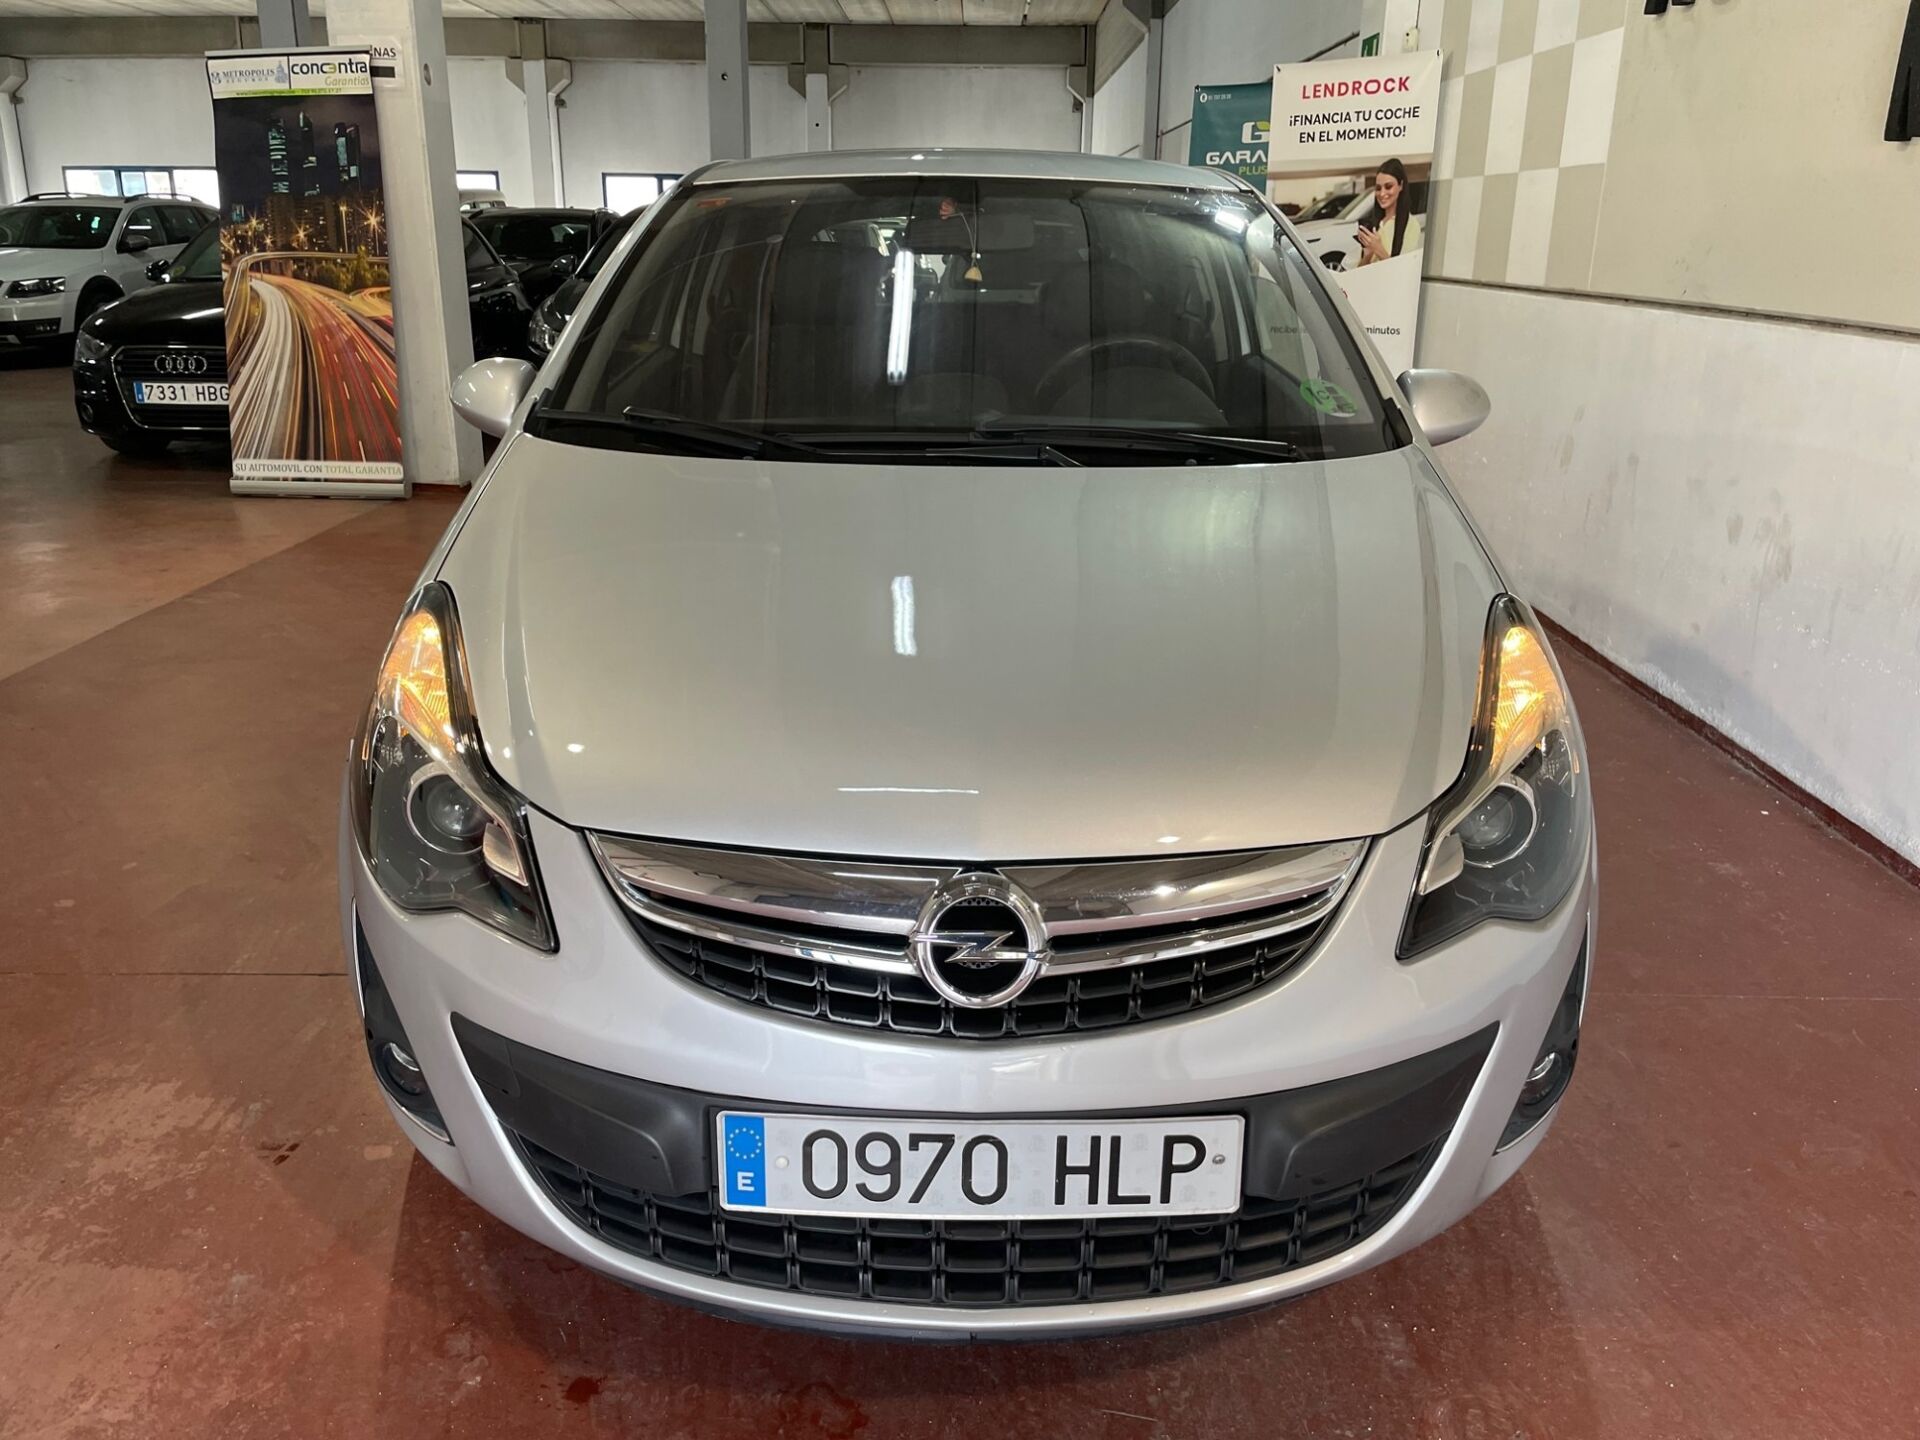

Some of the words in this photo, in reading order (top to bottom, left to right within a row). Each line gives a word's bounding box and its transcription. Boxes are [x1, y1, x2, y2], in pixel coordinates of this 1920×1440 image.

[222, 69, 275, 78] METROPOLIS
[1302, 76, 1410, 100] LENDROCK
[1289, 111, 1352, 127] ¡FINANCIA
[1354, 110, 1372, 122] TU
[1375, 106, 1420, 120] COCHE
[1299, 131, 1316, 143] EN
[1319, 130, 1333, 142] EL
[1336, 125, 1407, 141] MOMENTO!
[145, 385, 187, 401] 7331
[195, 386, 230, 401] HBG
[235, 463, 247, 472] SU
[249, 464, 302, 473] AUTOMOVIL
[304, 465, 323, 473] CON
[324, 465, 353, 474] TOTAL
[355, 466, 401, 475] GARANTIA
[737, 1172, 754, 1191] E
[801, 1129, 1009, 1206] 0970
[1054, 1134, 1207, 1206] HLP
